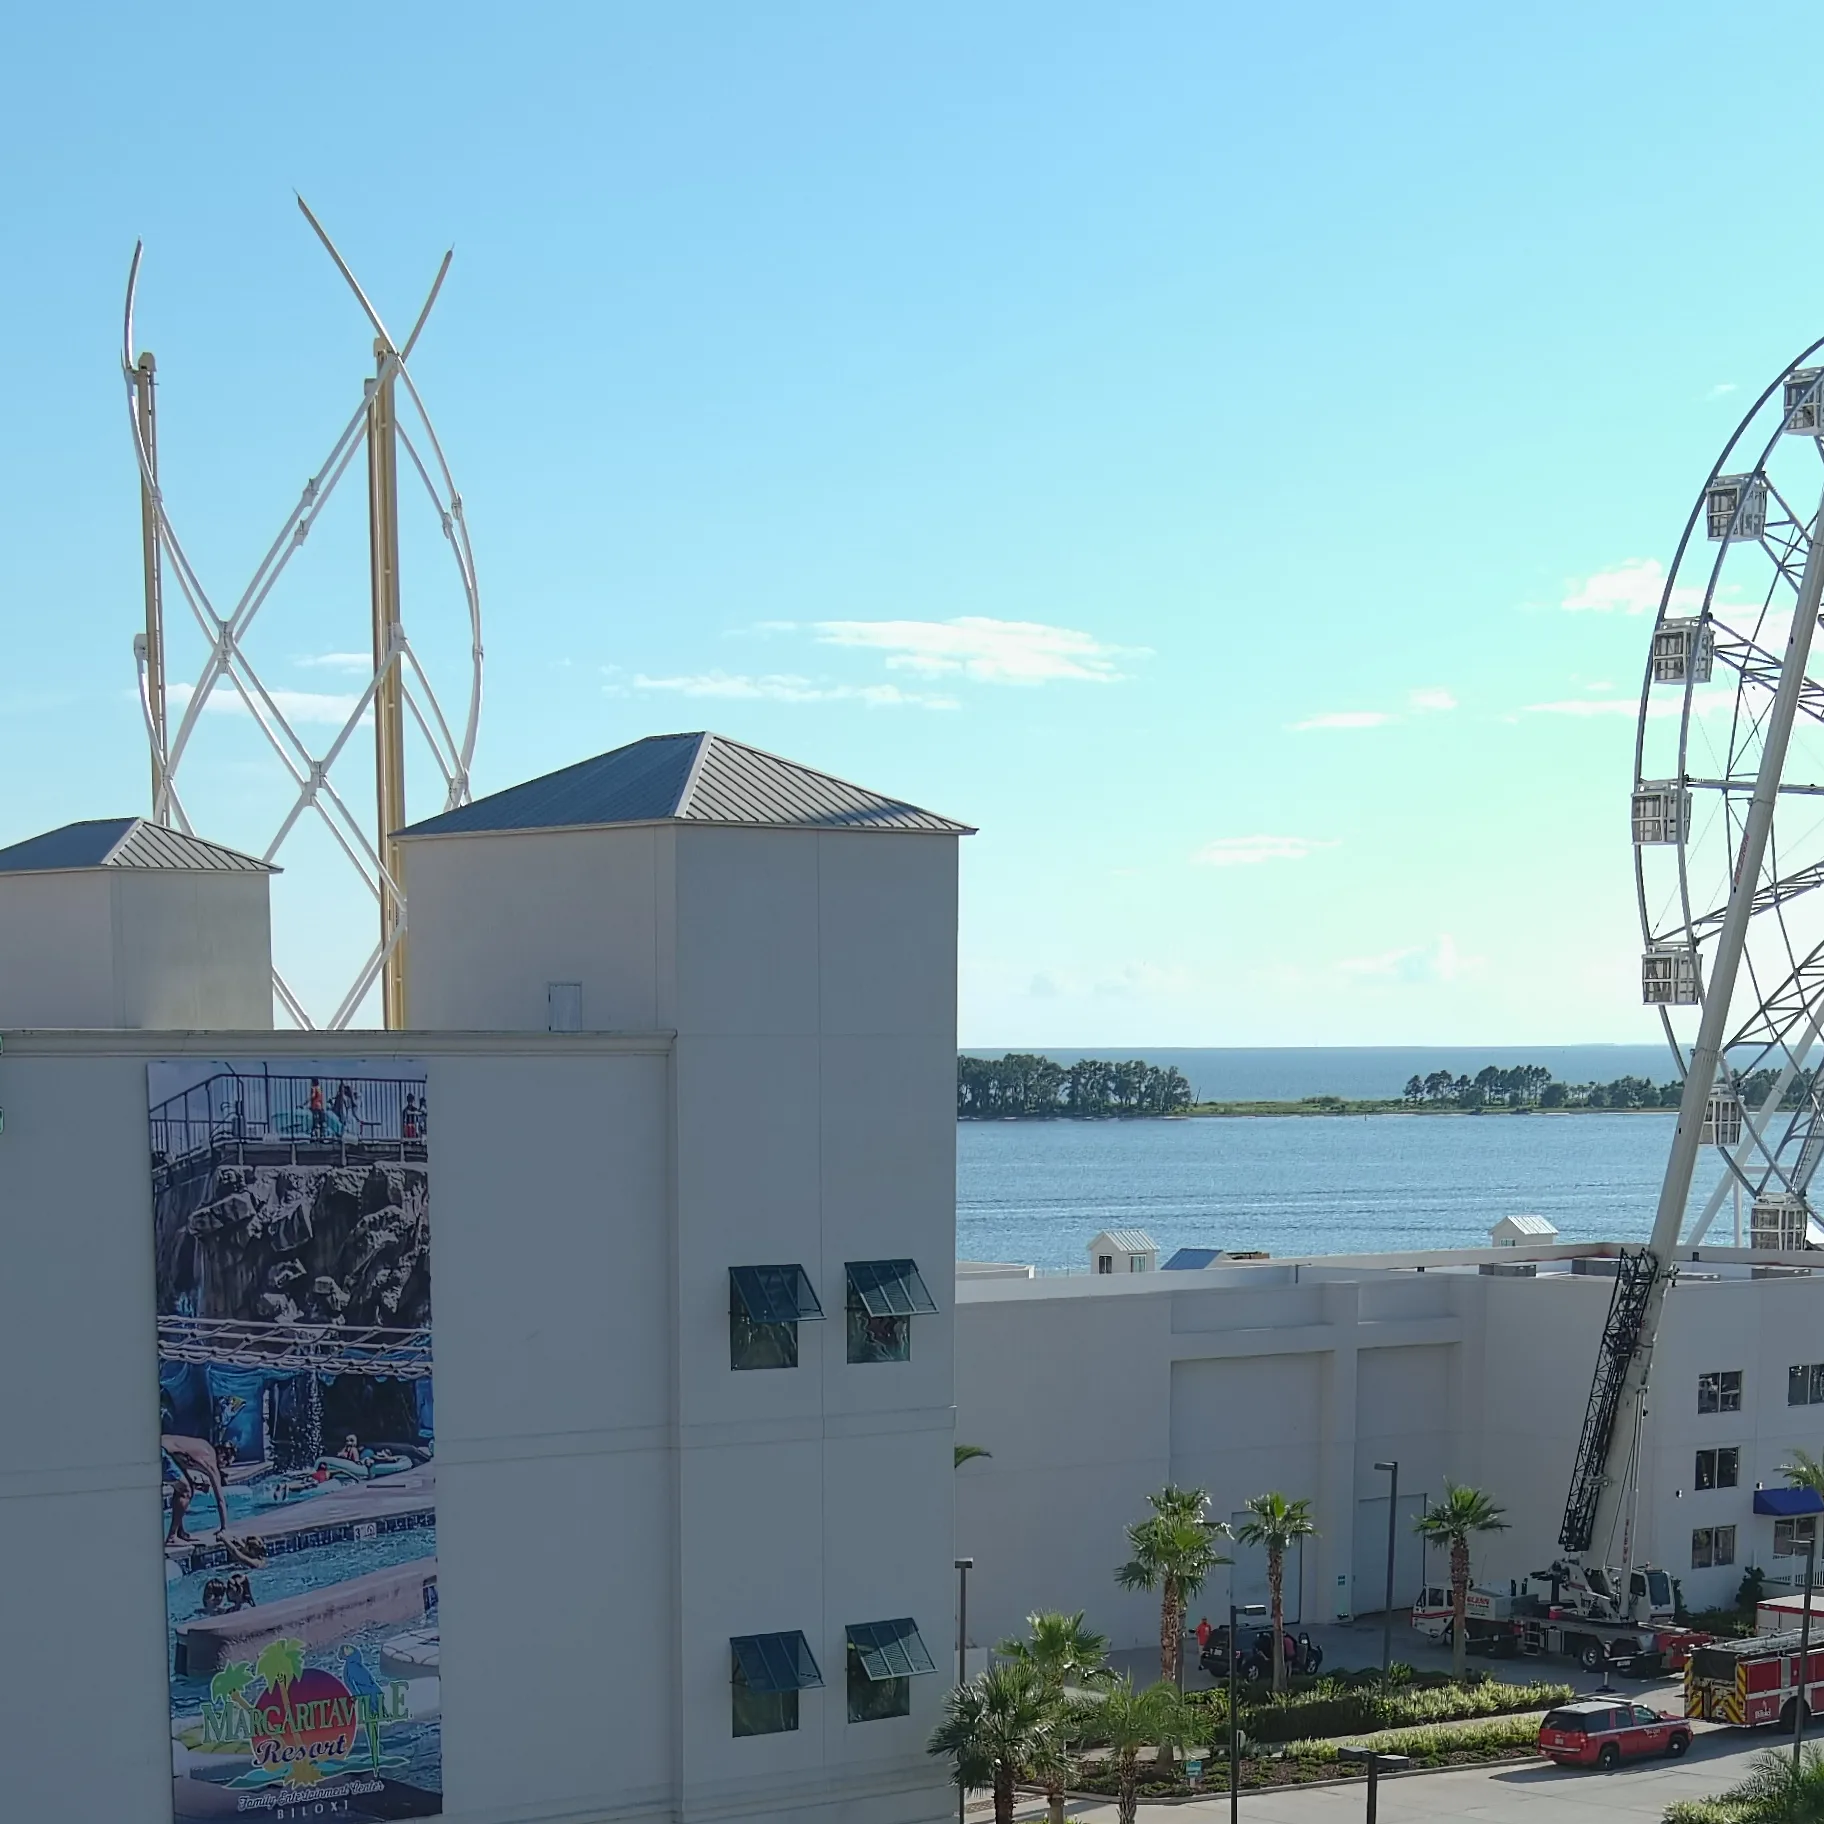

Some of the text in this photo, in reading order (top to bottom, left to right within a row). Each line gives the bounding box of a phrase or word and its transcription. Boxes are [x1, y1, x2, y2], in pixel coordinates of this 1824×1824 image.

[200, 1680, 413, 1744] MARGARITAVILLE
[253, 1733, 347, 1767] Resort
[237, 1794, 277, 1812] Family
[278, 1782, 350, 1806] Entertainment
[277, 1800, 349, 1820] BILOXI
